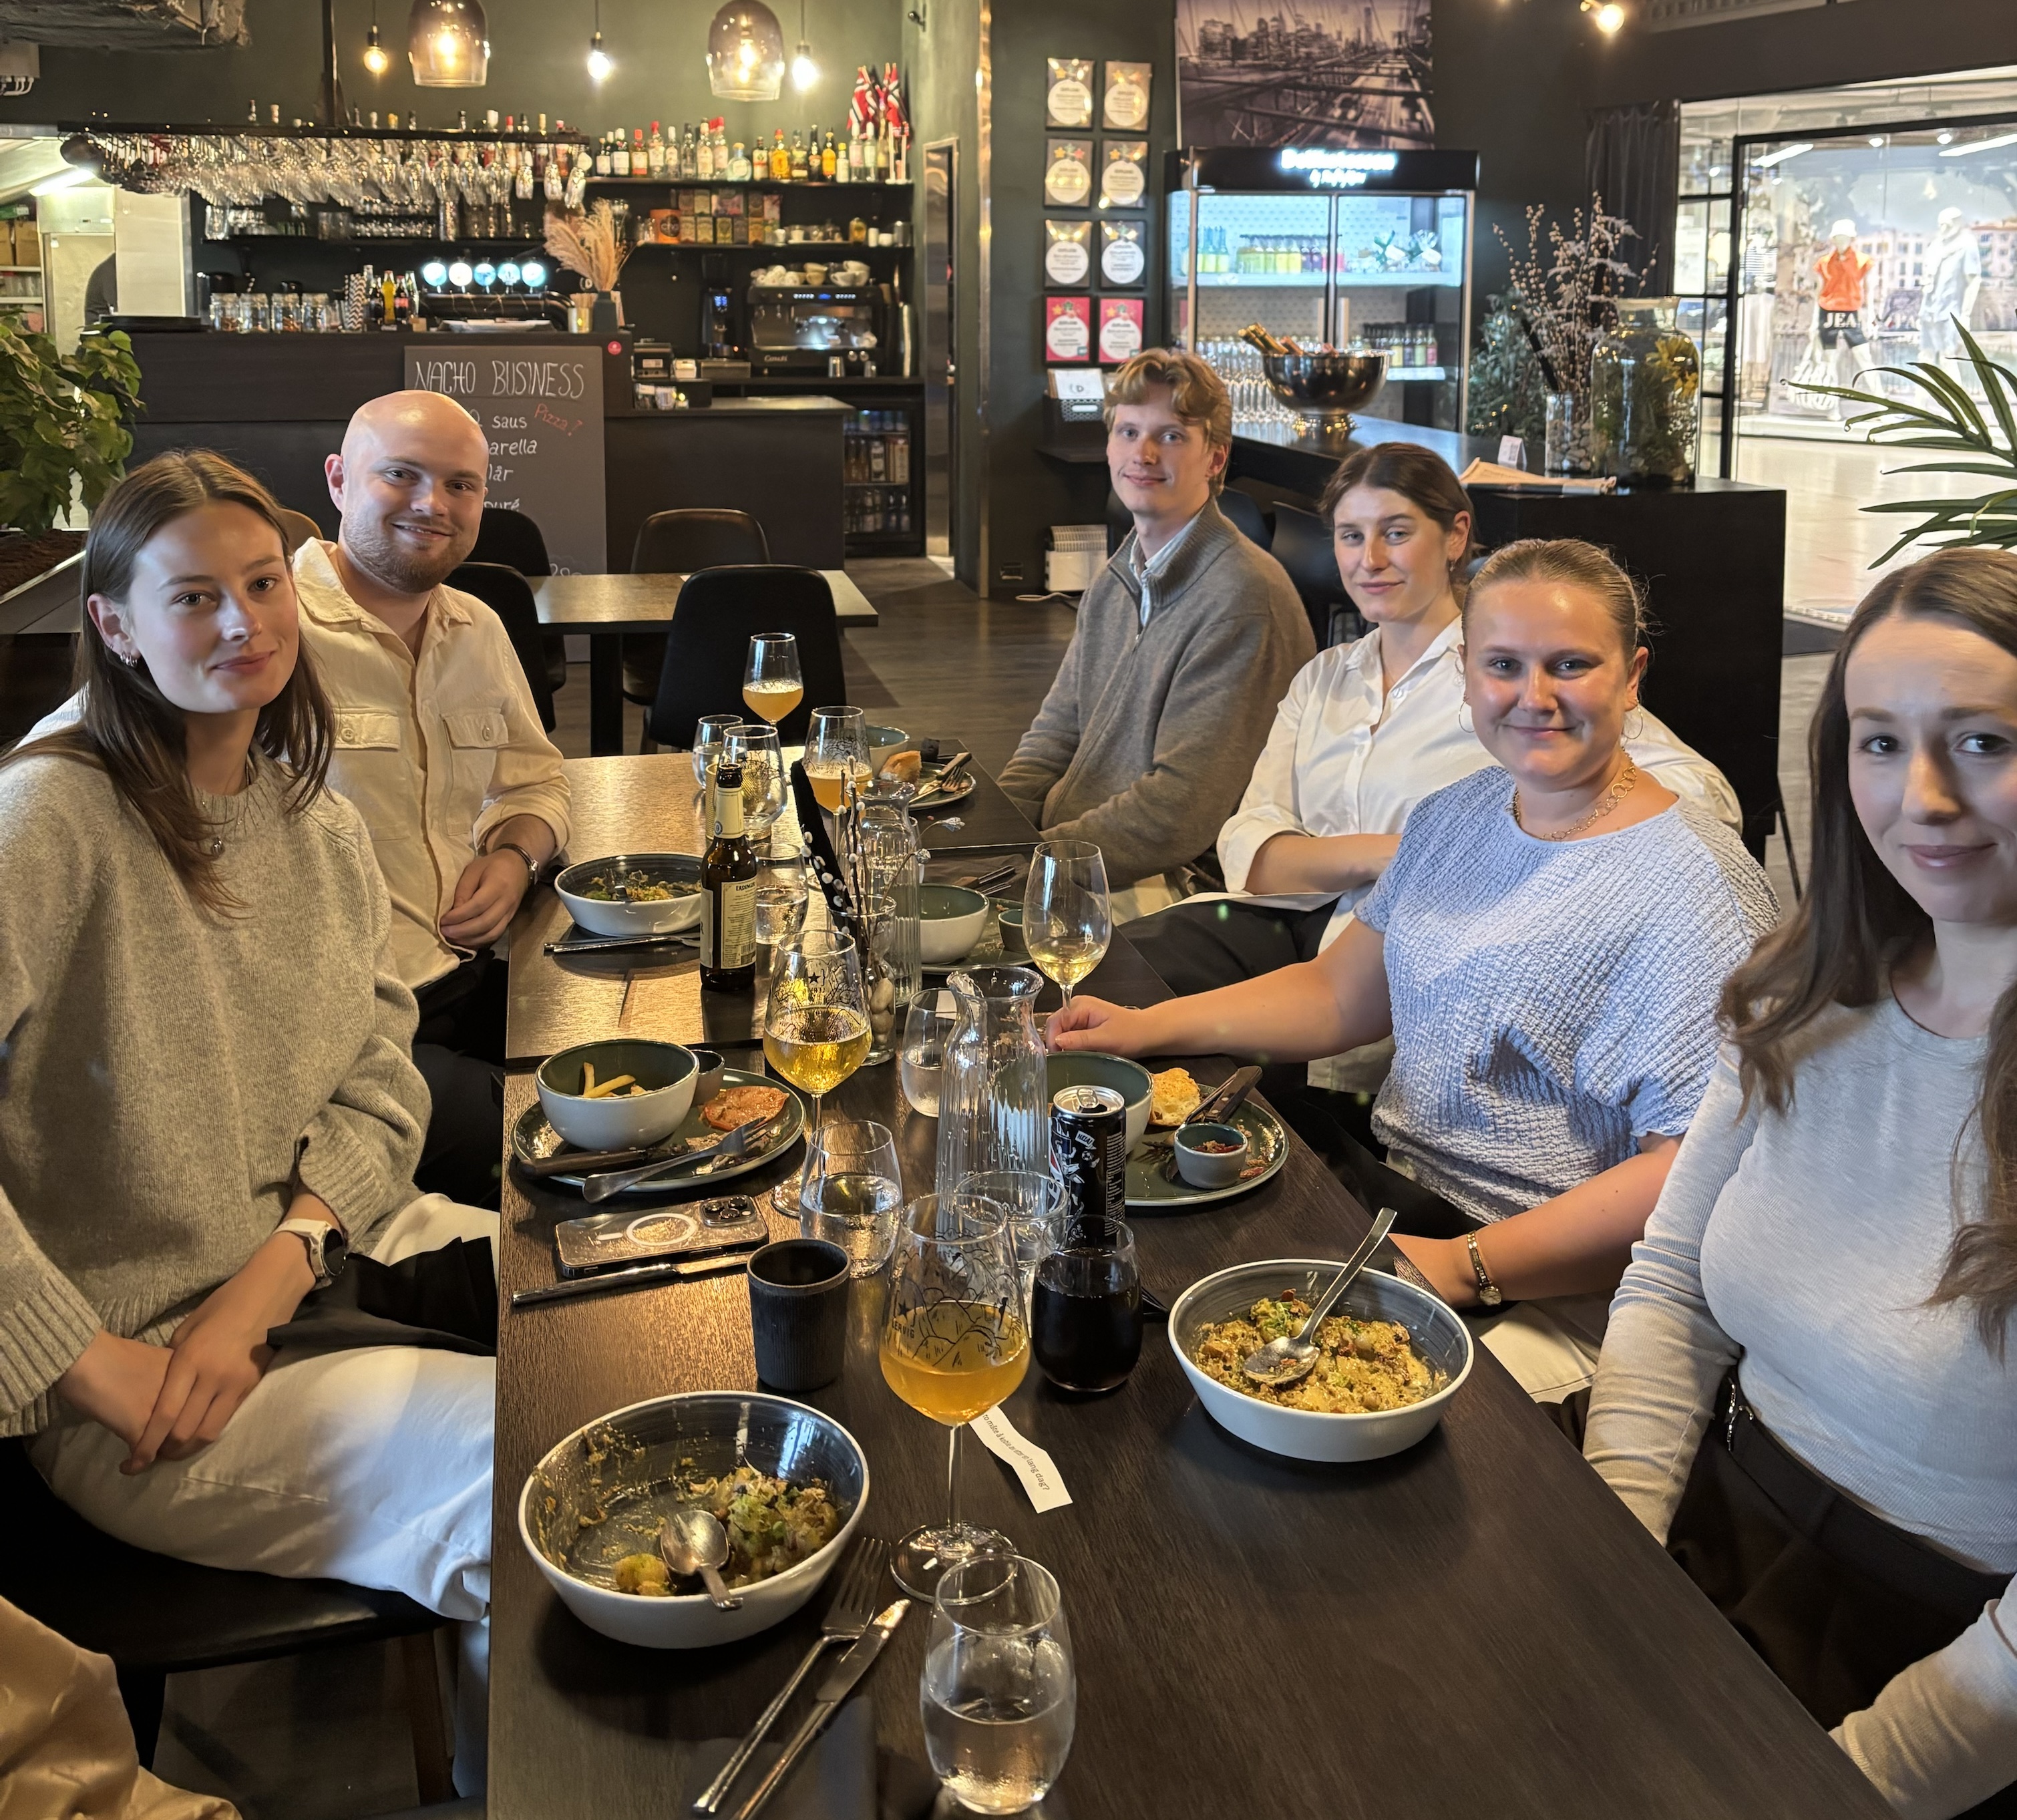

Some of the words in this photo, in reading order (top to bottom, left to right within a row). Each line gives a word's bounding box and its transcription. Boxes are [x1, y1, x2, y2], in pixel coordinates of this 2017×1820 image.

[1823, 312, 1859, 329] JEA
[415, 361, 476, 395] NACHO
[492, 360, 584, 399] BUSINESS
[492, 415, 528, 429] saus
[489, 438, 538, 456] arella
[488, 464, 514, 482] lår
[892, 1318, 914, 1338] LERVIG
[1026, 1458, 1039, 1473] lang
[1035, 1473, 1050, 1490] dag?
